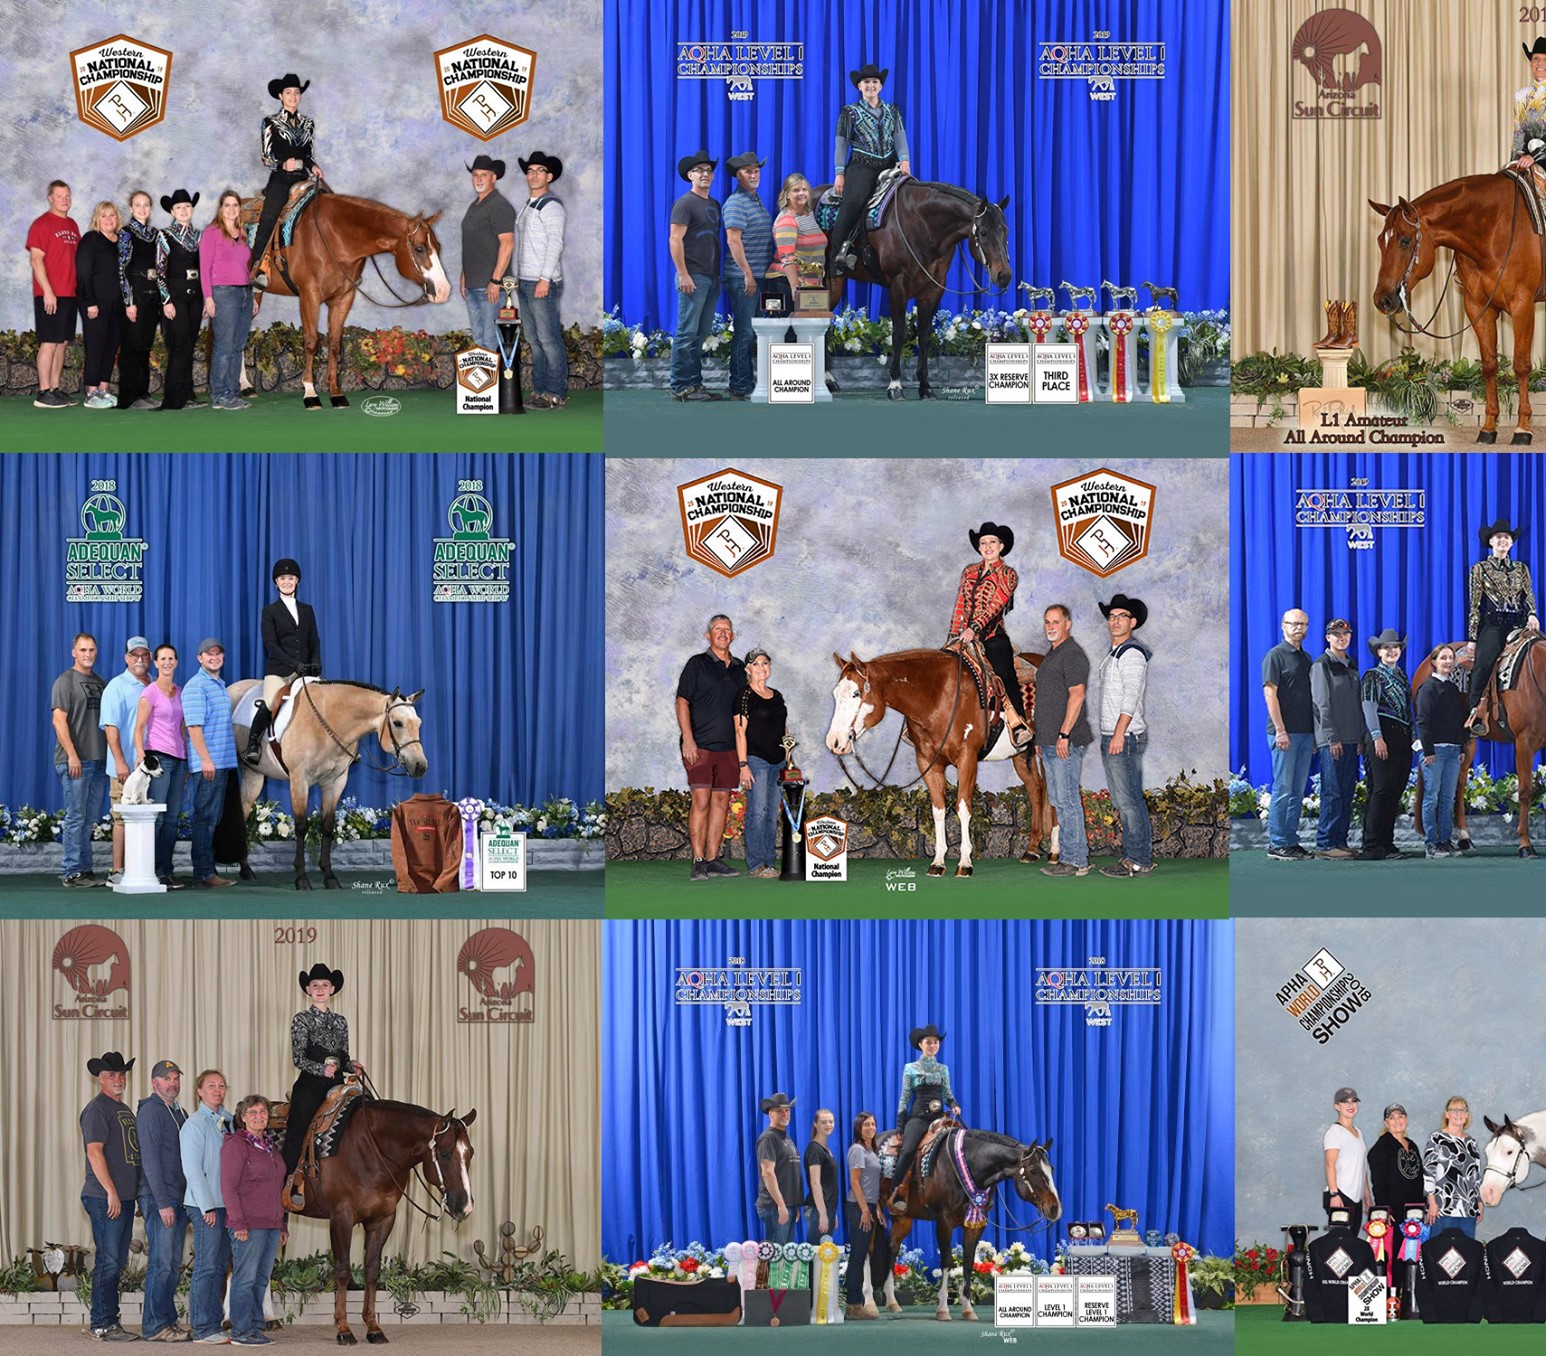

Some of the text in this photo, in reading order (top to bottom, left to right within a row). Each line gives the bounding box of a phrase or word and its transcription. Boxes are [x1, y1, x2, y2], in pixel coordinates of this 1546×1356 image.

[98, 47, 144, 58] Western
[678, 46, 796, 63] AQHA LEVEL
[86, 58, 155, 73] NATIONAL
[451, 58, 519, 73] NATIONAL
[678, 63, 804, 76] CHAMPIONSHIPS
[79, 69, 163, 86] CHAMPIONSHIP
[444, 69, 527, 86] CHAMPIONSHIP
[1318, 90, 1356, 100] Arizona
[1294, 101, 1380, 117] Sun Circuit
[1044, 371, 1068, 380] THIRD
[1042, 382, 1070, 390] PLACE
[463, 403, 493, 411] Champion
[90, 479, 117, 492] 2018
[707, 481, 754, 492] Western
[695, 492, 765, 507] NATIONAL
[1296, 492, 1415, 512] AQHA LEVEL
[687, 503, 774, 521] CHAMPIONSHIP
[1296, 511, 1425, 524] CHAMPIONSHIPS
[66, 562, 142, 580] SELECT
[490, 871, 517, 879] TOP 10
[812, 871, 842, 879] Champion
[676, 971, 792, 989] AQHA LEVEL
[1343, 972, 1372, 1002] 2018
[676, 988, 802, 1001] CHAMPIONSHIPS
[1275, 972, 1308, 1006] APHA
[74, 994, 107, 1003] Arizona
[1286, 983, 1321, 1018] WORLD
[1298, 977, 1350, 1032] CHAMPIONSHIP
[54, 1004, 128, 1017] Sun Circuit
[1311, 992, 1363, 1045] SHOW
